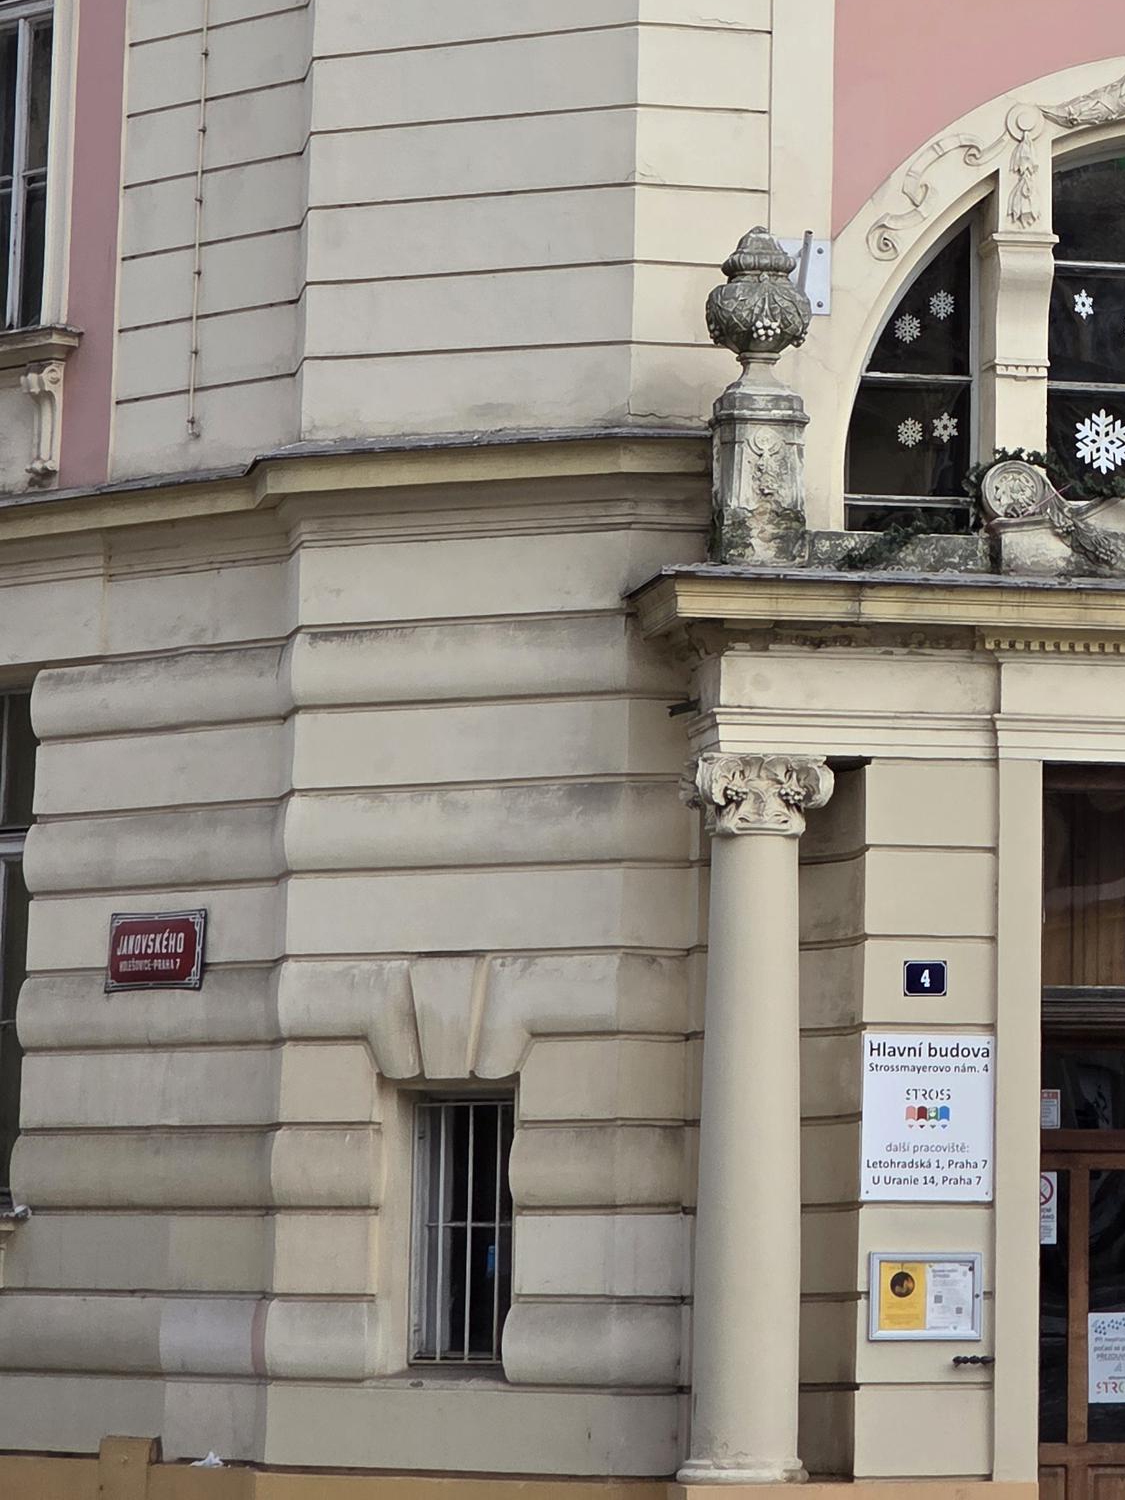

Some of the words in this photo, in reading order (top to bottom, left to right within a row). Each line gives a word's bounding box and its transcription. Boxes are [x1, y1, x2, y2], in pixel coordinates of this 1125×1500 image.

[117, 928, 185, 955] JANOVSKÉHO
[175, 958, 181, 970] 7
[920, 968, 931, 988] 4
[869, 1040, 924, 1058] Hlavní
[928, 1041, 991, 1059] budova
[868, 1063, 952, 1074] Strossmayerovo
[954, 1063, 980, 1073] nám.
[982, 1063, 990, 1073] 4
[905, 1088, 952, 1101] STROSS
[885, 1142, 910, 1153] další
[912, 1142, 971, 1155] pracoviště:
[866, 1158, 932, 1169] Letohradská
[935, 1160, 945, 1171] 1,
[948, 1159, 978, 1170] Praha
[981, 1160, 988, 1170] 7
[872, 1175, 881, 1186] U
[883, 1175, 919, 1186] Uranie
[922, 1176, 939, 1188] 14,
[942, 1176, 973, 1187] Praha
[975, 1176, 982, 1186] 7
